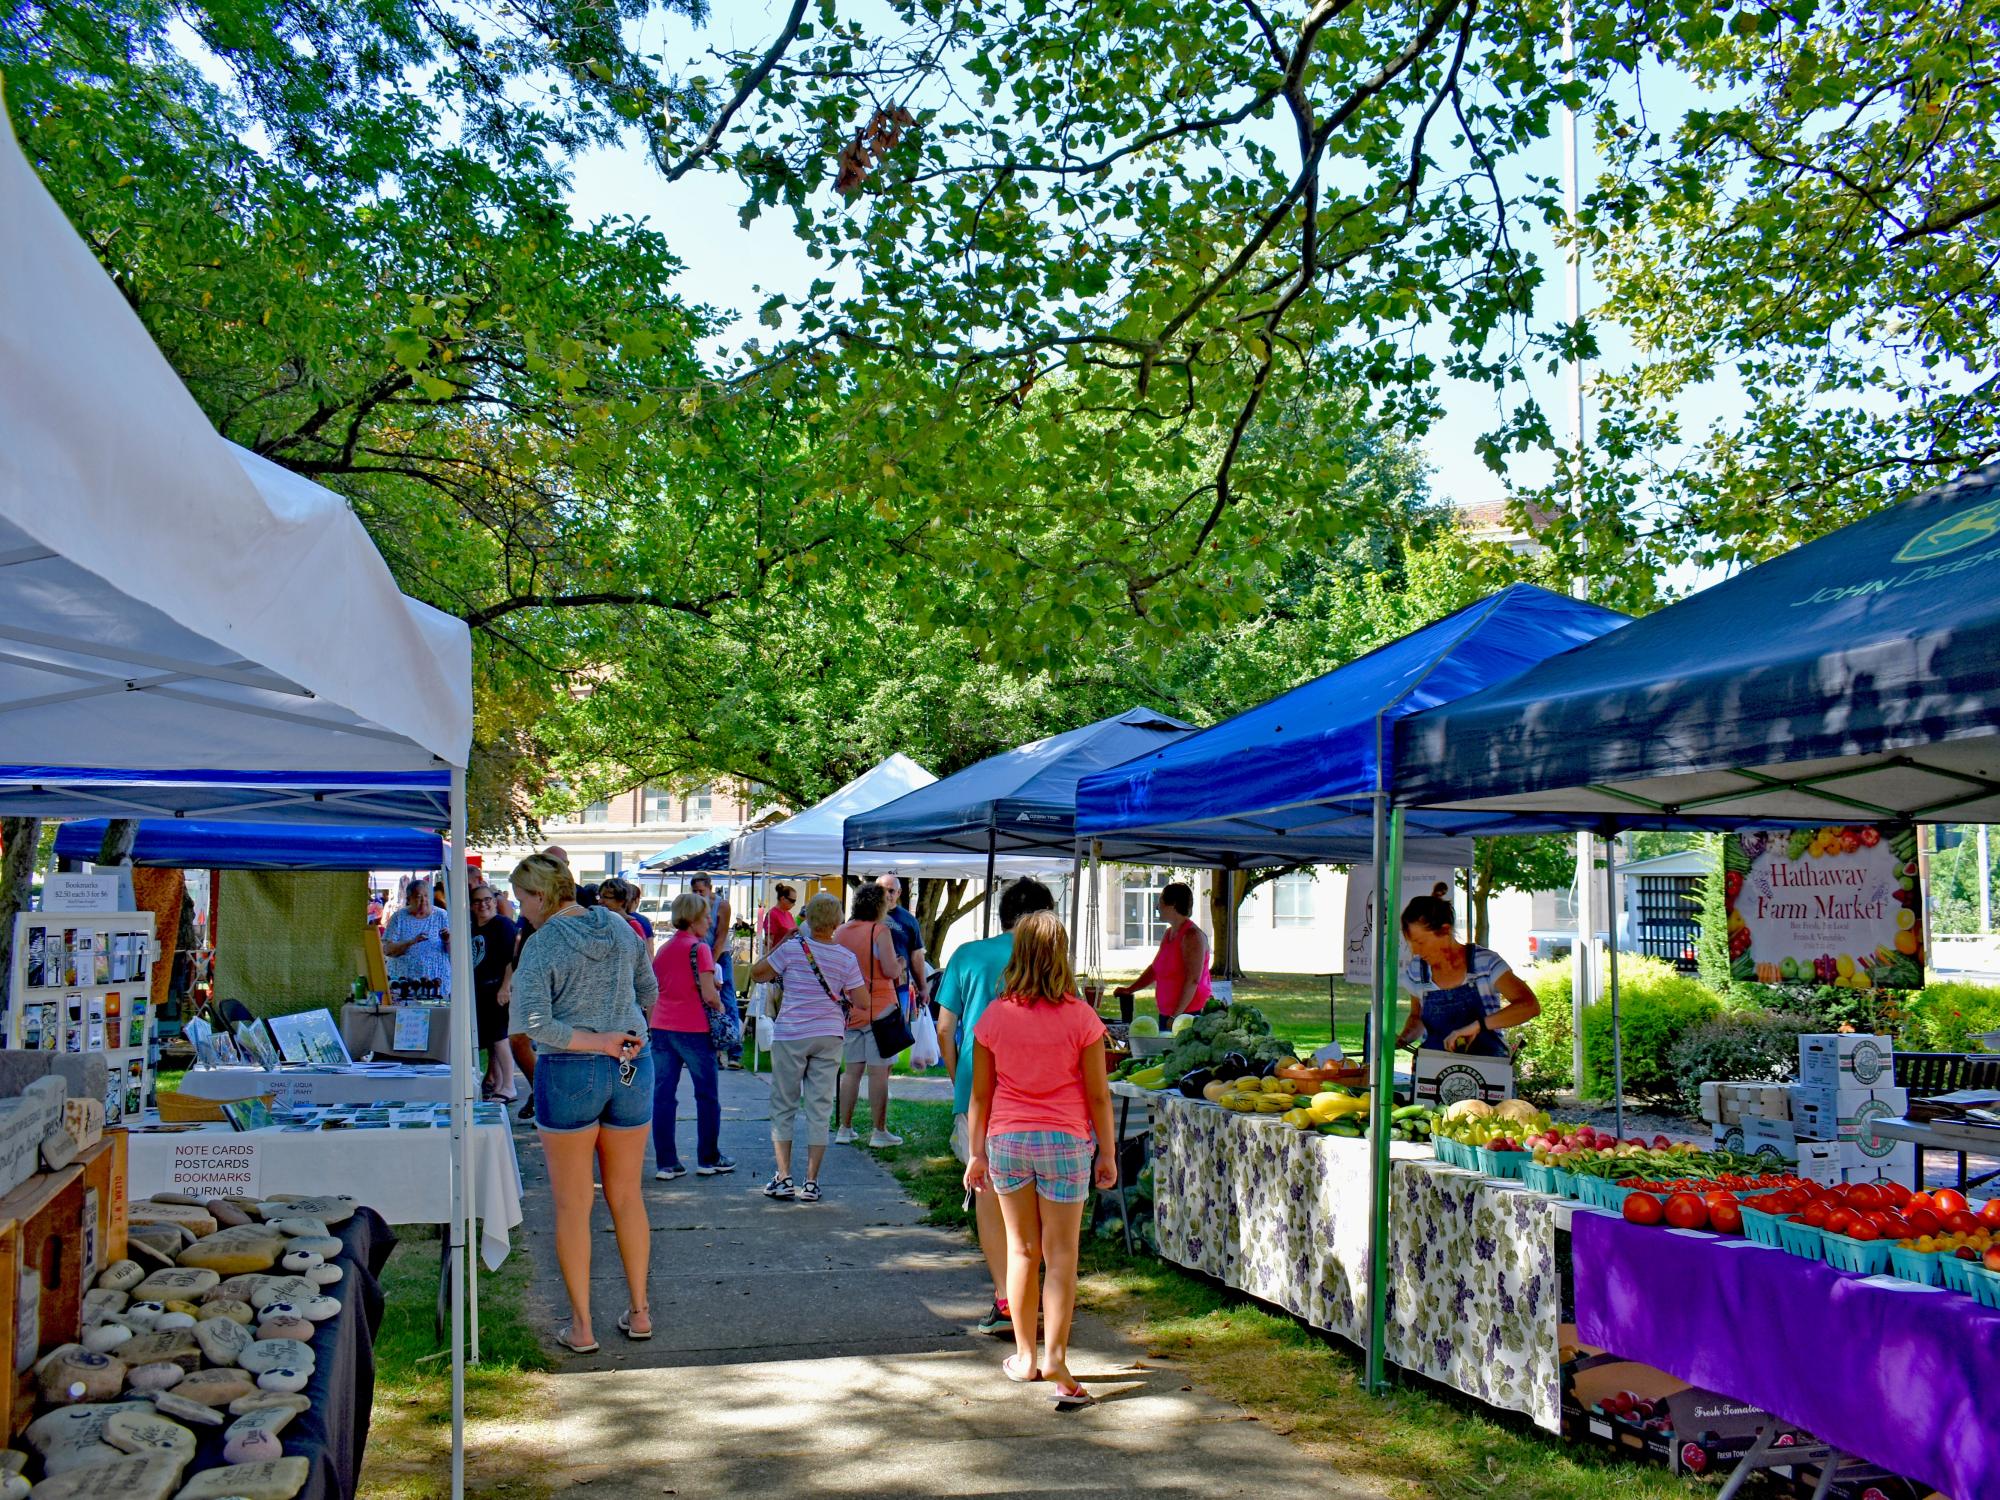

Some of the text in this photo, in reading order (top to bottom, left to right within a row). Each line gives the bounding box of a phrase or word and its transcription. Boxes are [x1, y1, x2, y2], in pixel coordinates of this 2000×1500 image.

[1790, 577, 1898, 607] JOHN
[1770, 862, 1867, 892] Hathaway
[65, 881, 98, 889] Bookmarks
[72, 890, 85, 898] each
[1757, 895, 1886, 919] Farm Market
[1439, 1066, 1458, 1079] FARM
[175, 1145, 254, 1155] NOTE CARDS
[175, 1159, 249, 1168] POSTCARDS
[174, 1173, 251, 1182] BOOKMARKS
[1694, 1405, 1720, 1418] Fresh
